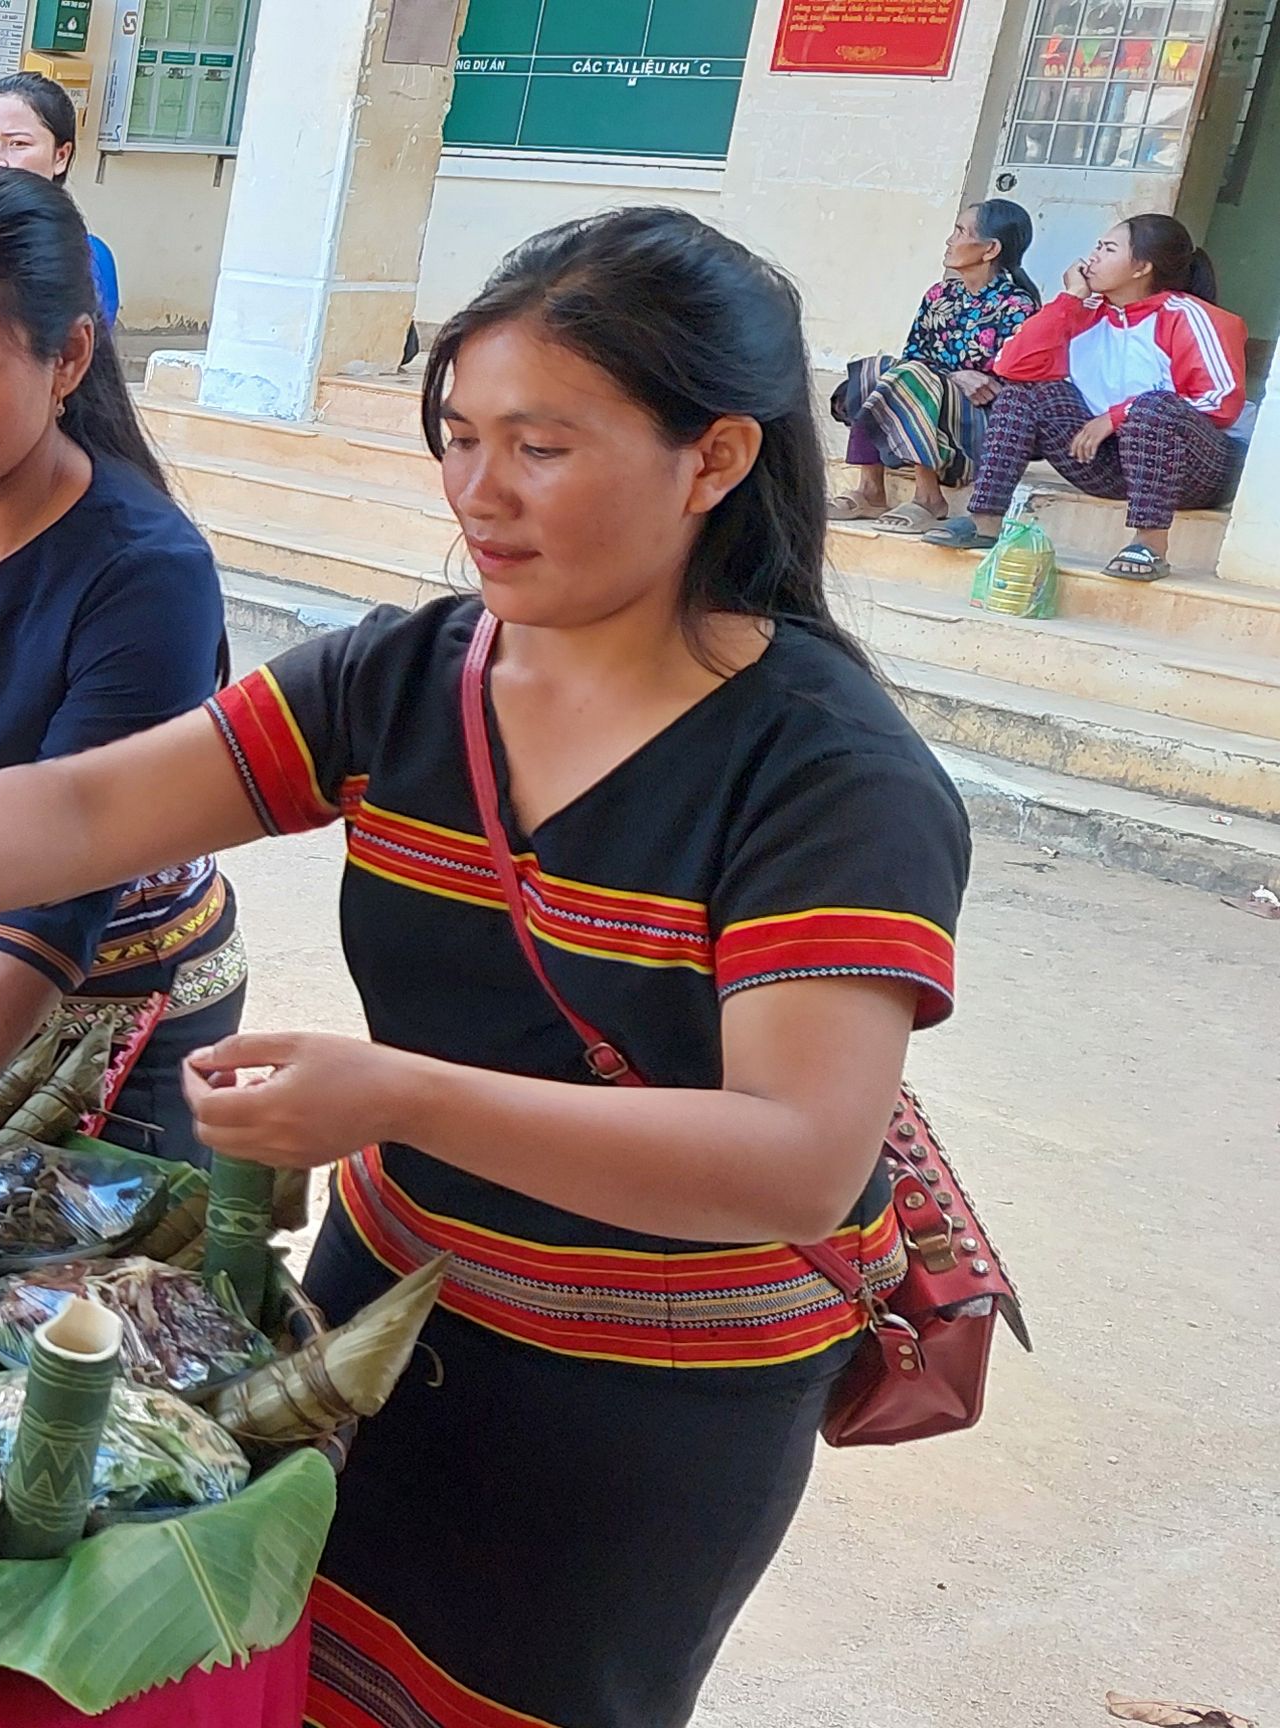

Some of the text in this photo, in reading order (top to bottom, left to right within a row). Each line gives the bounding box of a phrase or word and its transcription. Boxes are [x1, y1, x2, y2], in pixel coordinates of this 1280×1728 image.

[472, 58, 490, 72] DỰ
[488, 57, 506, 71] ÁN
[572, 58, 602, 73] CÁC
[605, 58, 630, 73] TÀI
[631, 59, 666, 76] LIỆU
